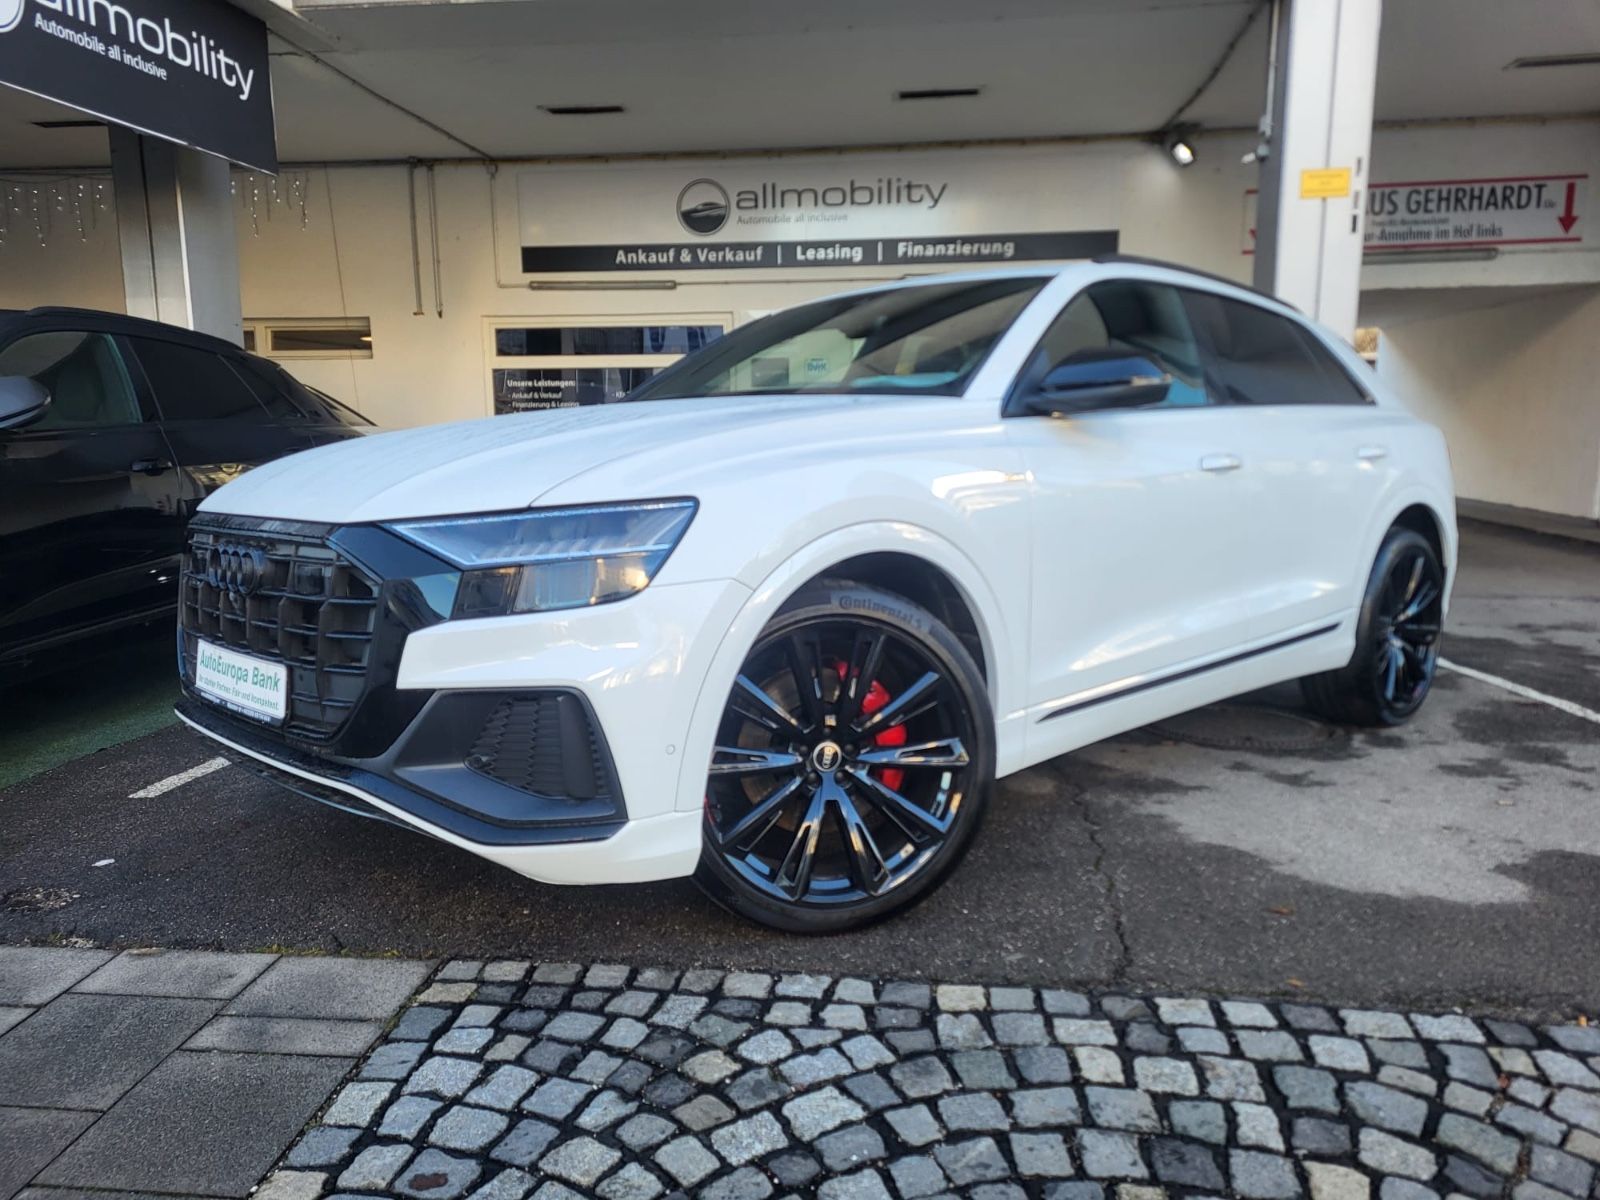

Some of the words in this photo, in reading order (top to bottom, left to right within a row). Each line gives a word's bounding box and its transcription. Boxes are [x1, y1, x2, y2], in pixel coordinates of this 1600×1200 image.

[34, 12, 106, 56] Automobile
[107, 43, 121, 62] all
[122, 50, 168, 81] inclusive
[36, 0, 254, 101] mobility
[735, 177, 948, 210] allmobility
[1366, 189, 1399, 216] US
[1406, 184, 1548, 214] GEHRHARDT
[736, 212, 792, 226] Automobile
[615, 247, 675, 264] Ankauf
[679, 247, 692, 264] &
[697, 245, 764, 263] Verkauf
[796, 243, 864, 263] Leasing
[897, 239, 1016, 259] Finanzierung
[507, 379, 533, 388] Unsere
[840, 595, 915, 624] Continental
[200, 649, 249, 685] AutoEuropa
[251, 666, 281, 692] Bank
